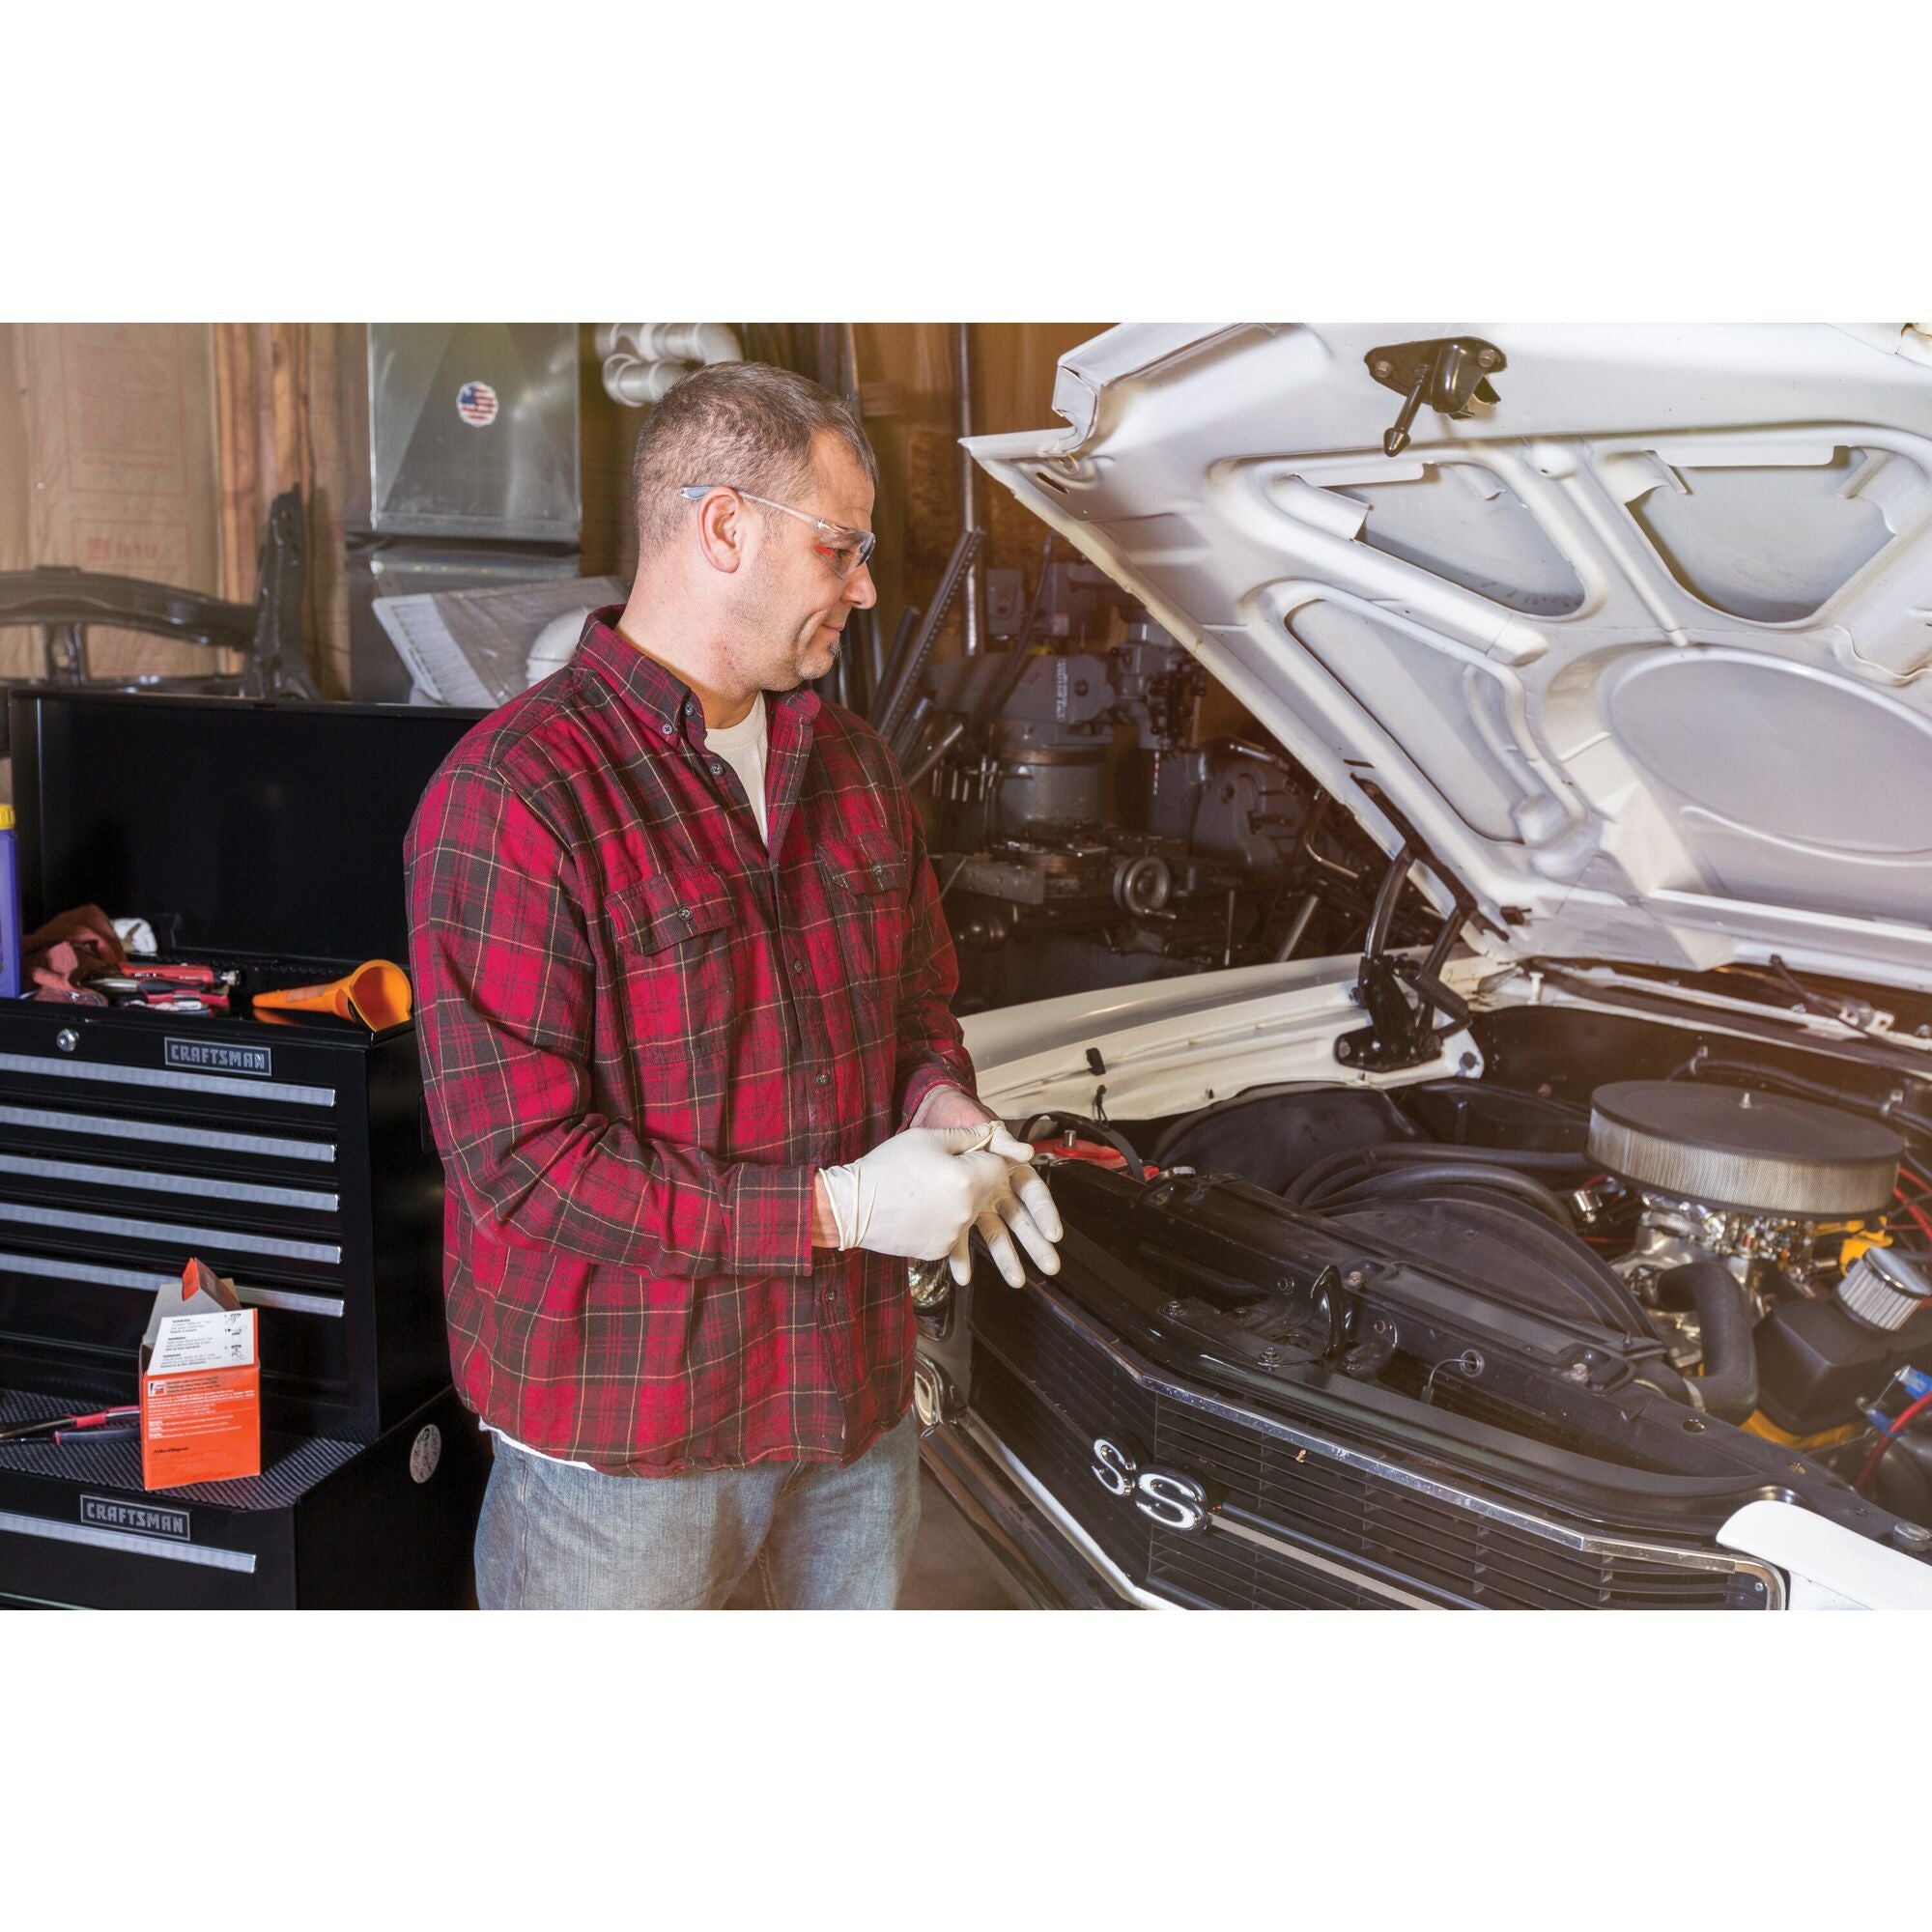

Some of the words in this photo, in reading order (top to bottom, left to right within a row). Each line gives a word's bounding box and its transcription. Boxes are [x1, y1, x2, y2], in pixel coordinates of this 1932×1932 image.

[170, 1044, 265, 1069] CRAFTSMAN
[1091, 1438, 1201, 1531] SS
[86, 1502, 184, 1533] CRAFTSMAN
